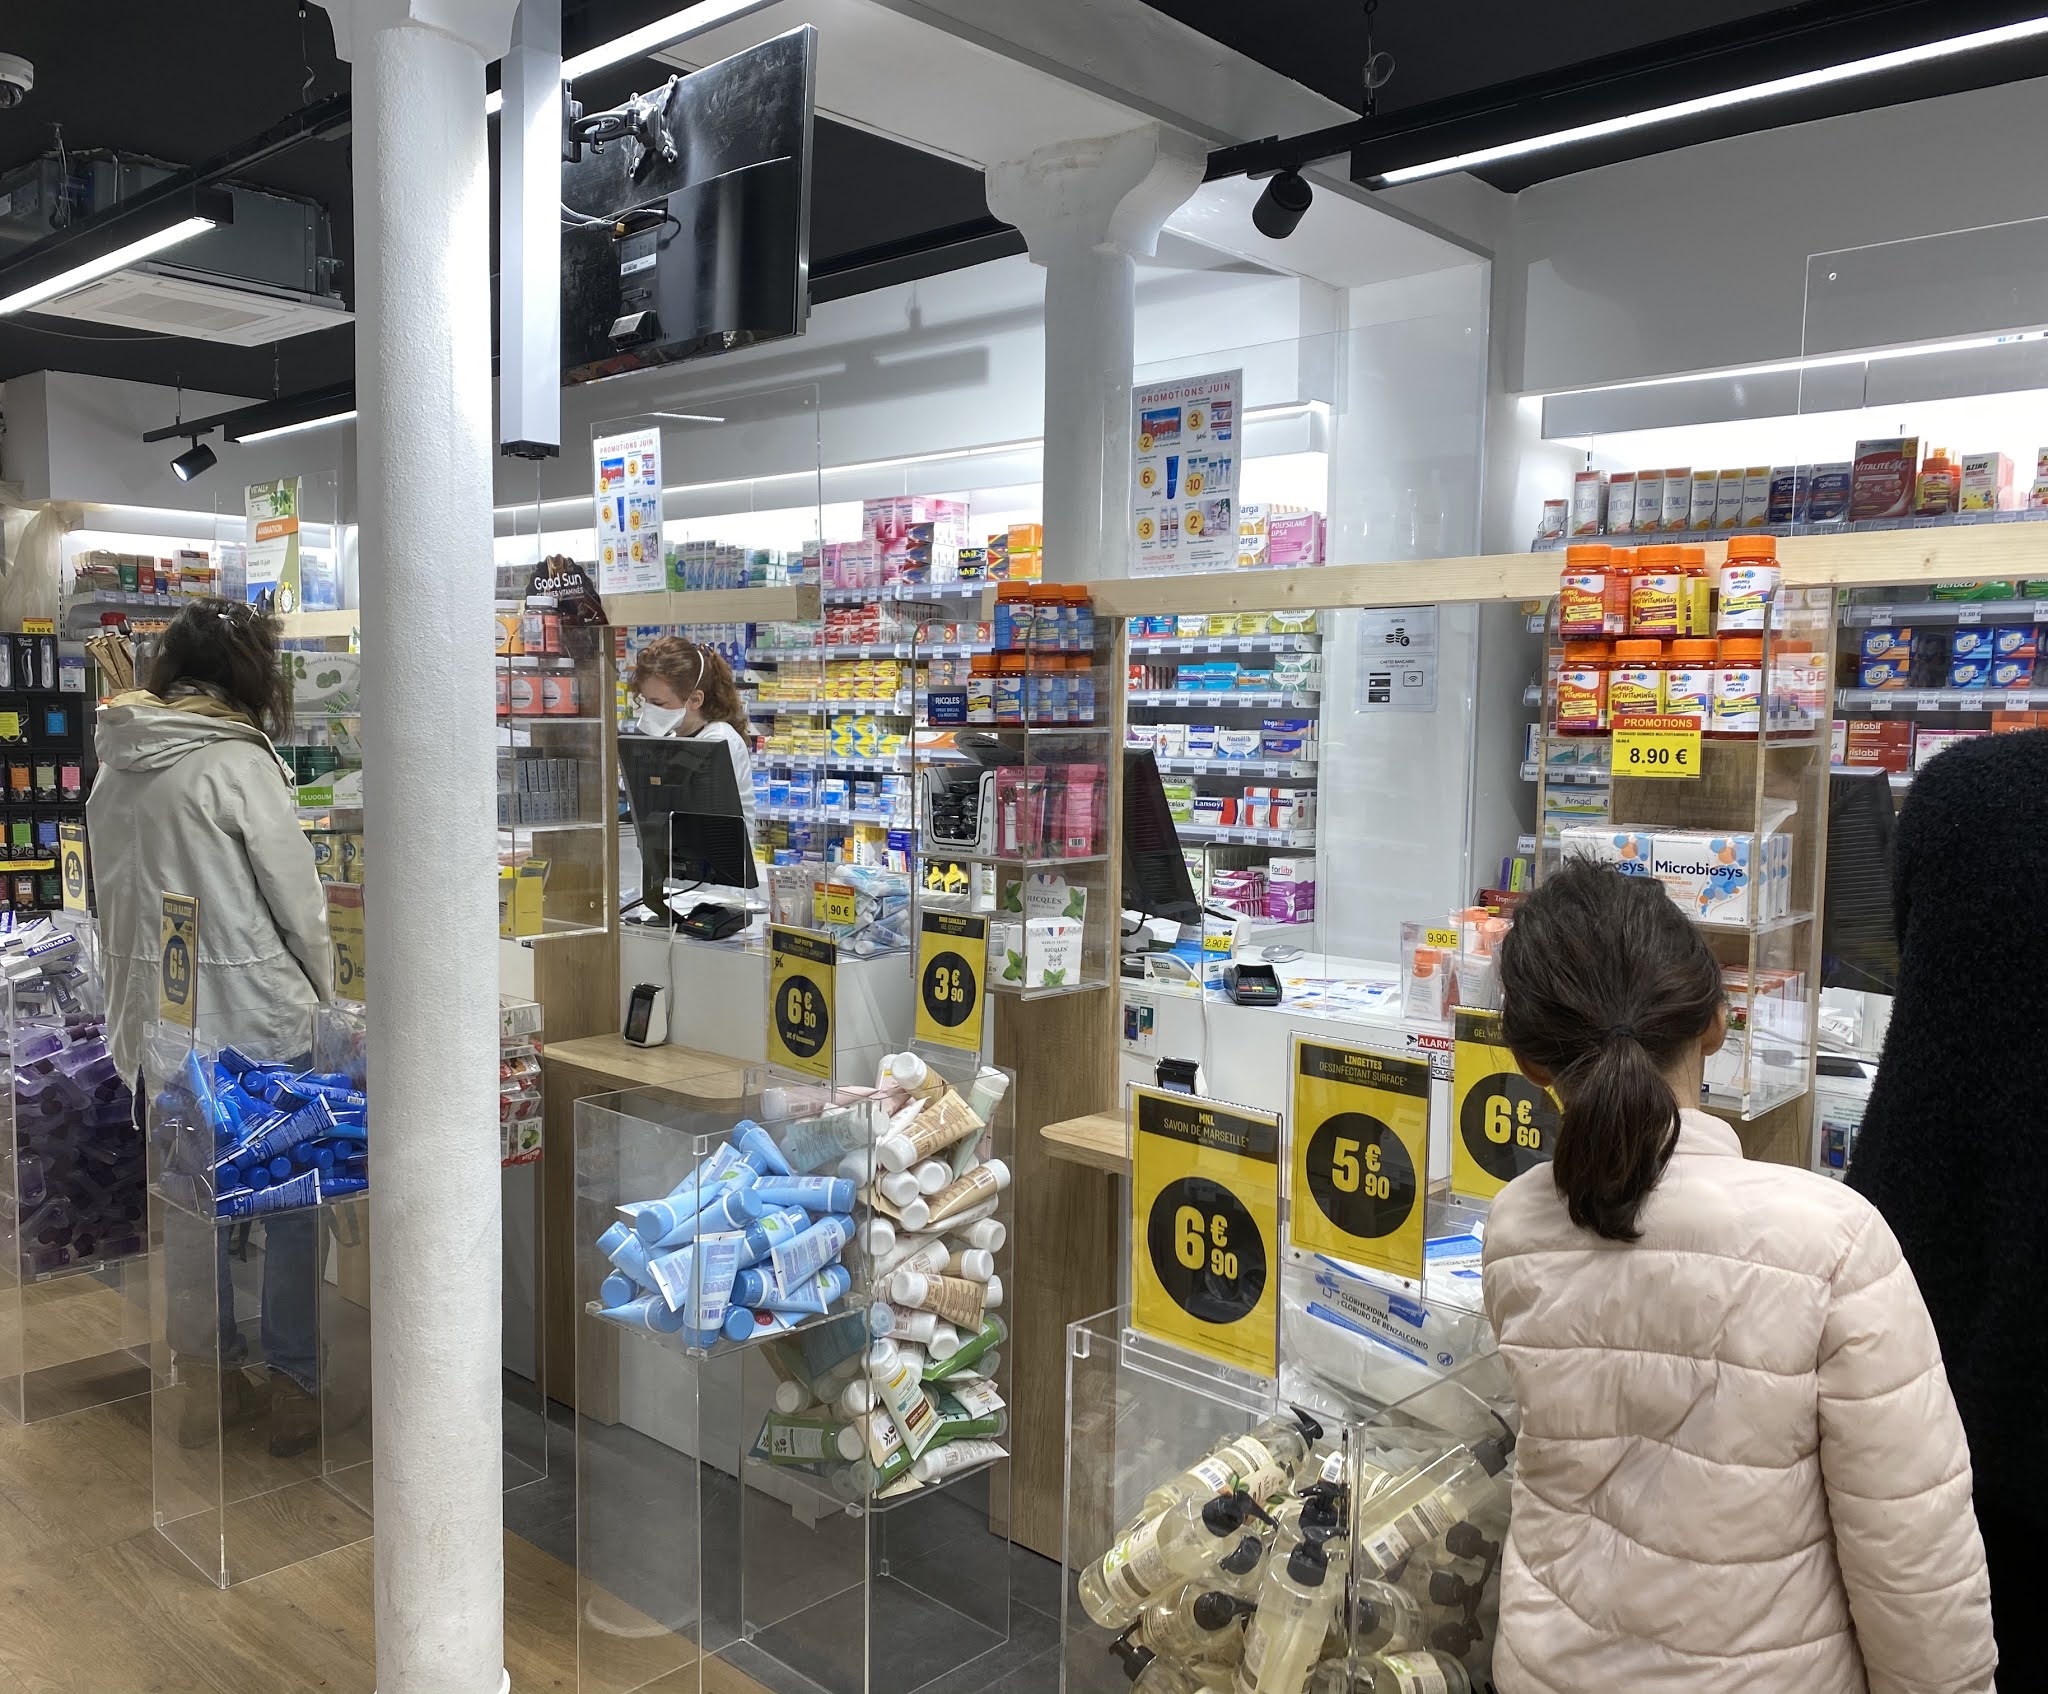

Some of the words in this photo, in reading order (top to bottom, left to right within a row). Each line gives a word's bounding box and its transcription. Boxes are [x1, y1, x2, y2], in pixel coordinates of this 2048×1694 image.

[1141, 387, 1204, 404] PROMOTIONS
[1208, 382, 1231, 394] JUIN
[600, 442, 637, 454] PROMOTIONS
[639, 438, 654, 448] JUIN
[1856, 461, 1890, 471] VITALITÉ
[1966, 462, 1988, 471] AZINC
[258, 524, 283, 536] ANIMATION
[1271, 520, 1307, 529] POLYSILANE
[534, 573, 561, 590] Good
[562, 573, 582, 587] Sun
[305, 657, 327, 668] Menthol
[1624, 718, 1693, 728] PROMOTIONS
[1630, 747, 1669, 765] 8.90
[1675, 749, 1687, 765] €
[300, 793, 332, 801] FLUOGUM
[1195, 800, 1223, 812] Lansoyl
[1565, 796, 1592, 807] Arnigel
[1655, 860, 1743, 881] Microbiosys
[843, 907, 849, 916] €
[1205, 938, 1222, 948] 2.90
[1427, 933, 1448, 943] 9.90
[1450, 935, 1457, 944] E
[169, 947, 178, 980] 6
[336, 943, 353, 985] 5
[935, 967, 949, 1000] 3
[952, 969, 960, 987] €
[804, 992, 812, 1010] €
[951, 987, 963, 1002] 90
[787, 987, 802, 1024] 6
[804, 1012, 816, 1028] 90
[1474, 1029, 1486, 1038] GEL
[1419, 1038, 1454, 1050] ALARME
[1319, 1061, 1371, 1079] DESINFECTANT
[1344, 1055, 1382, 1070] LINGETTES
[1199, 1112, 1215, 1126] MKL
[1485, 1095, 1512, 1144] 6
[1516, 1100, 1532, 1124] €
[1163, 1118, 1189, 1133] SAVON
[1191, 1124, 1201, 1136] DE
[1516, 1126, 1540, 1149] 60
[1332, 1136, 1360, 1192] 5
[1365, 1143, 1382, 1172] €
[1365, 1176, 1390, 1200] 90
[1174, 1205, 1205, 1270] 6
[1210, 1214, 1228, 1247] €
[1211, 1252, 1238, 1280] 90
[1341, 1292, 1389, 1321] CLORHEXIDINA
[1341, 1300, 1370, 1319] CLORURO
[1371, 1316, 1381, 1326] DE
[1382, 1320, 1429, 1350] BENZALCONIO
